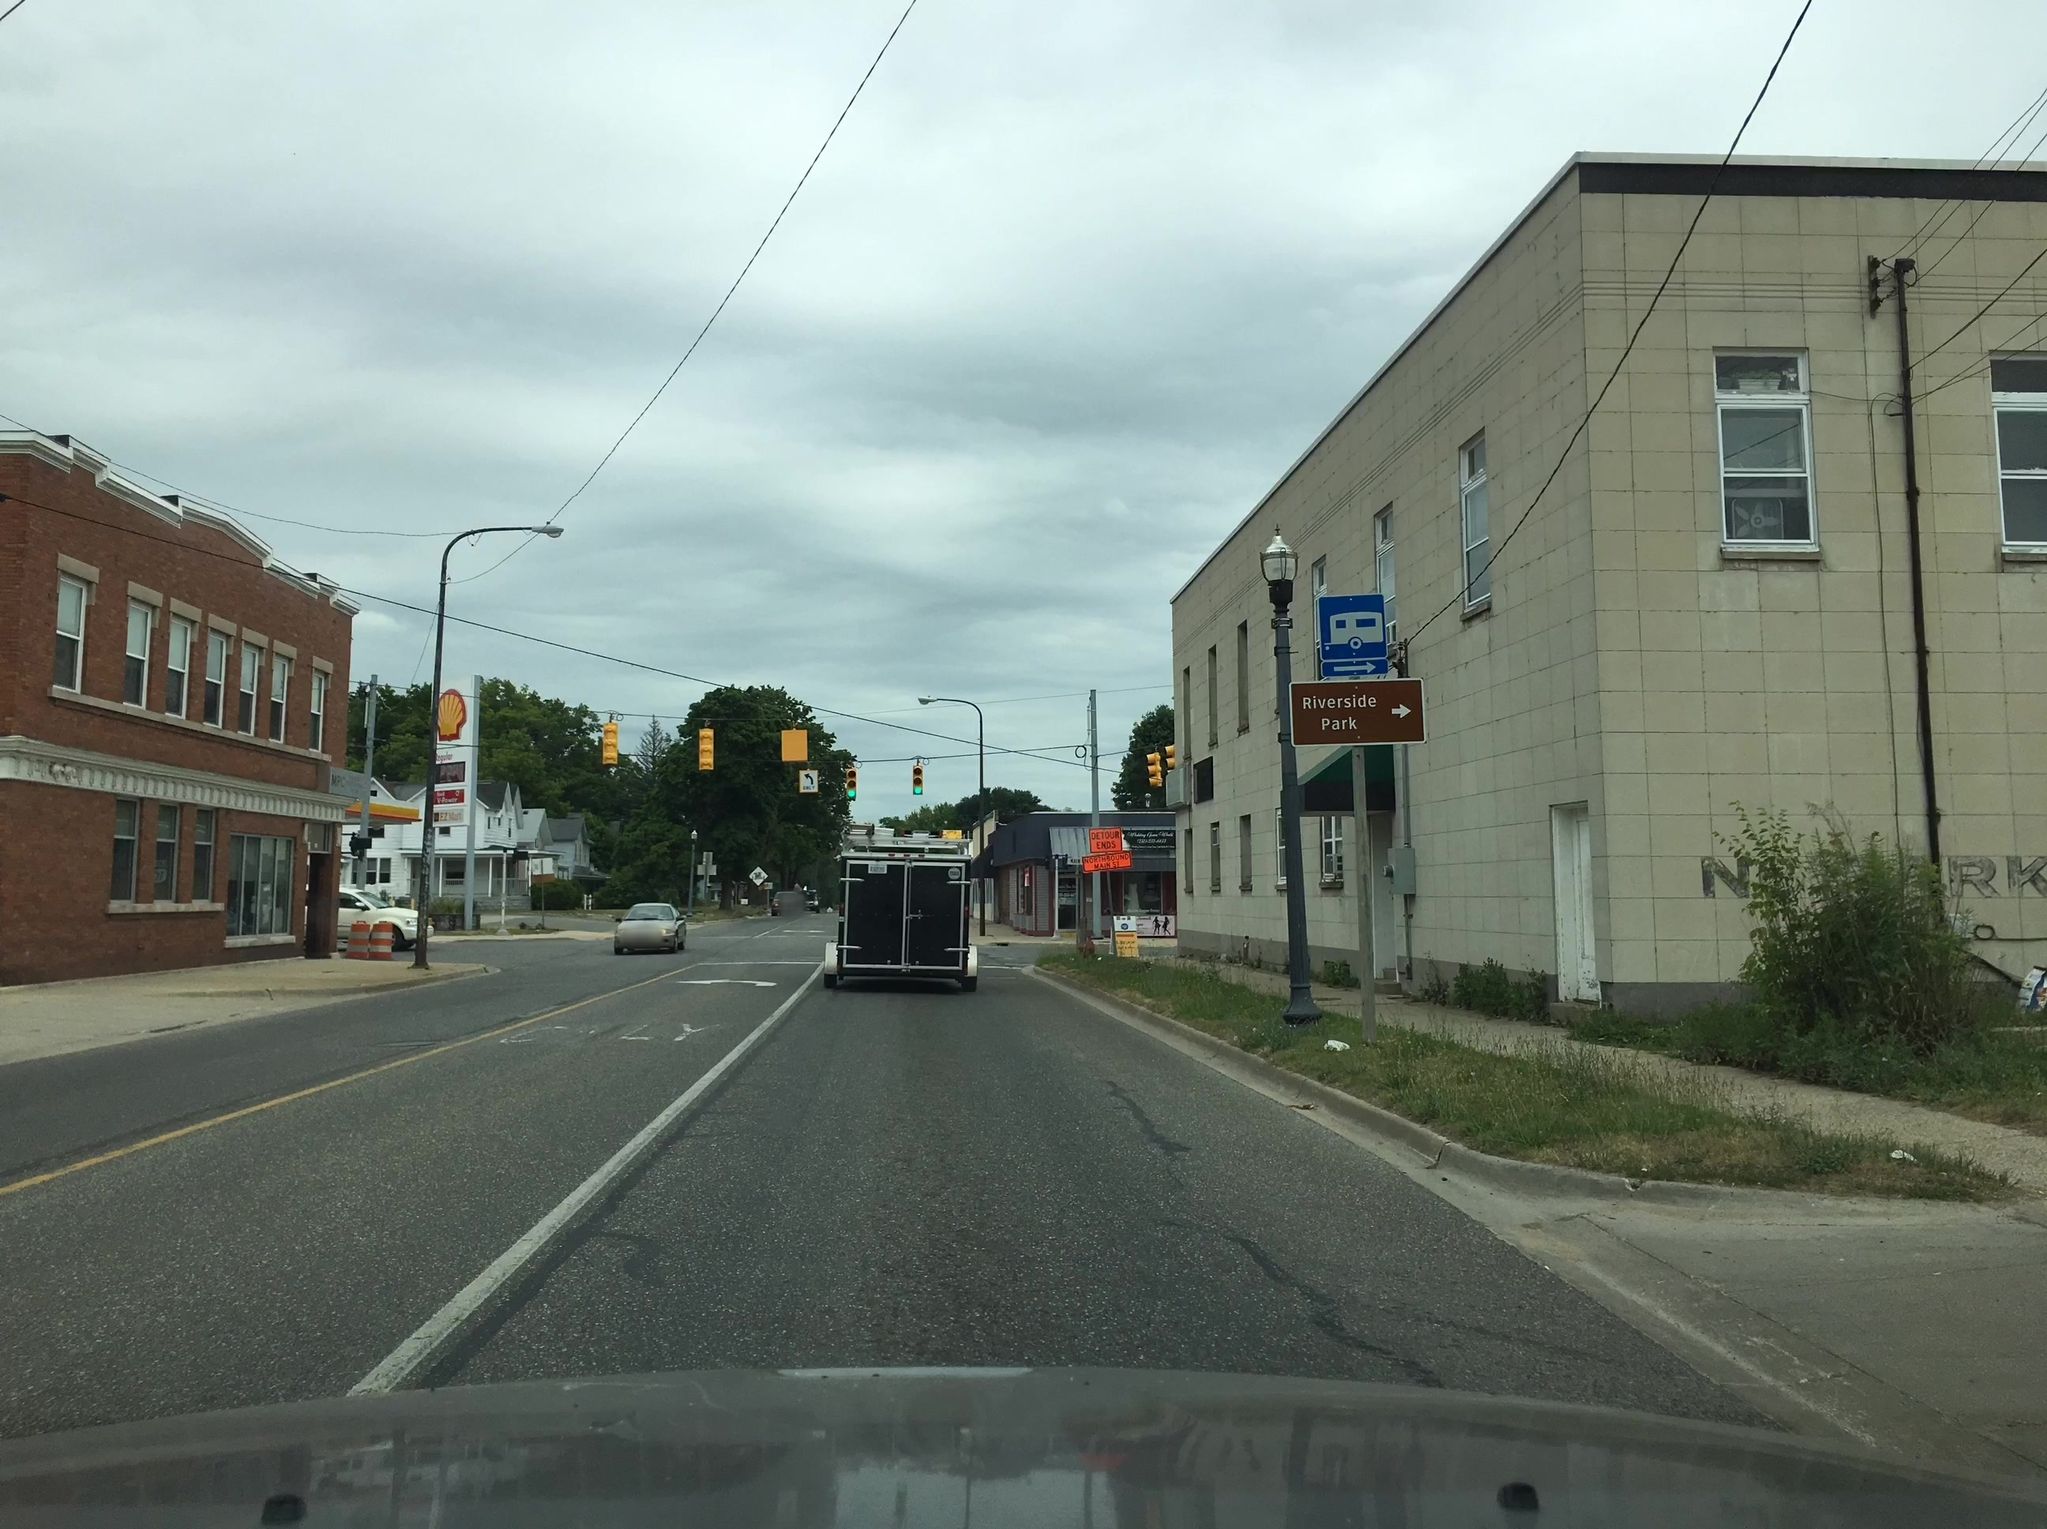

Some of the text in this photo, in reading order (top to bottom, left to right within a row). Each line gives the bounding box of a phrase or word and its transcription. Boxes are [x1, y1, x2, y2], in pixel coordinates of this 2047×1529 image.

[1302, 694, 1377, 710] Riverside
[1321, 716, 1358, 731] Park
[1091, 830, 1120, 840] DETOUR
[1096, 841, 1116, 849] ENDS
[1084, 853, 1129, 864] NORTHBOUND
[1094, 861, 1111, 869] MAIN
